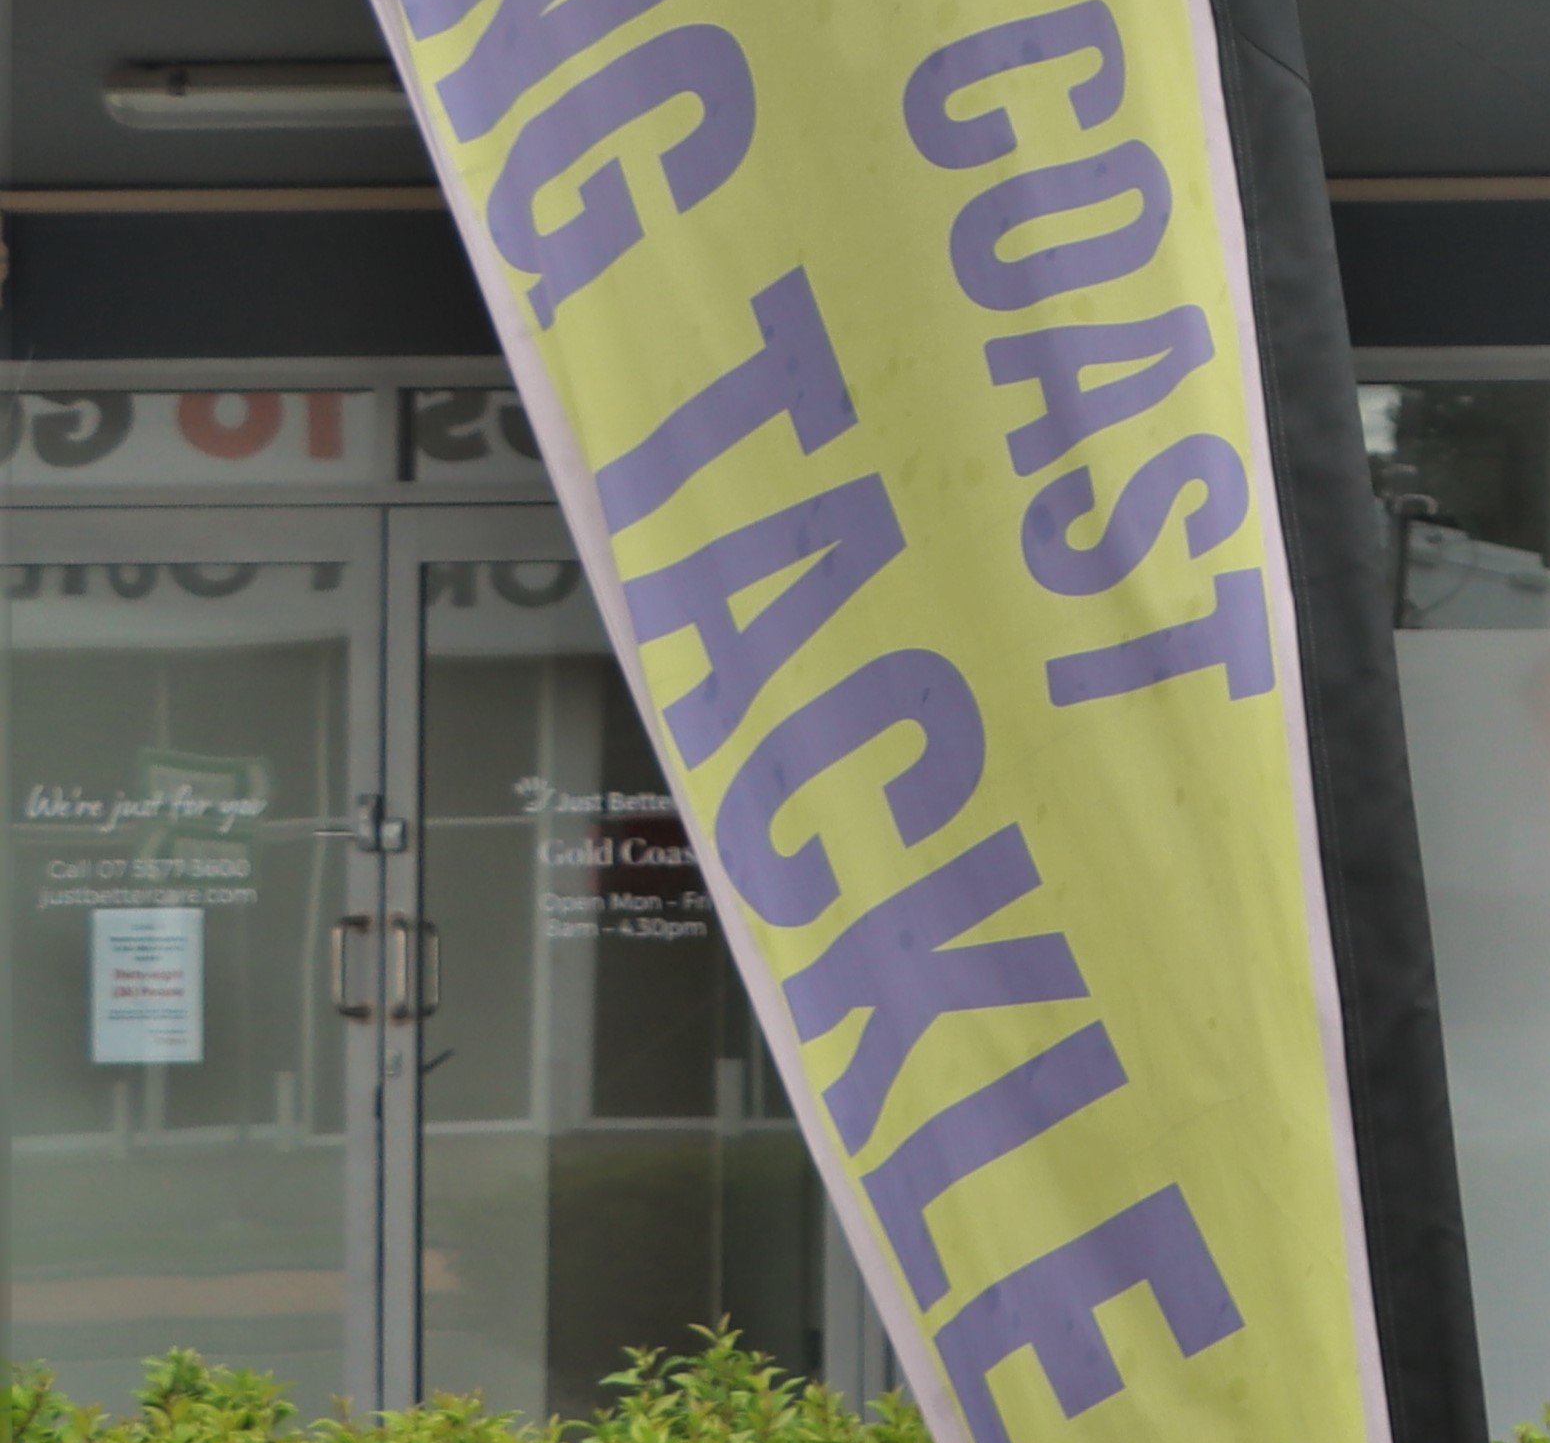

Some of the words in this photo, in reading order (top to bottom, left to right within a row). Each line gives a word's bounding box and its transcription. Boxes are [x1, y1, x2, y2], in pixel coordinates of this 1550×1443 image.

[606, 791, 676, 812] Bette
[539, 838, 614, 866] Gold
[618, 837, 697, 866] Coas
